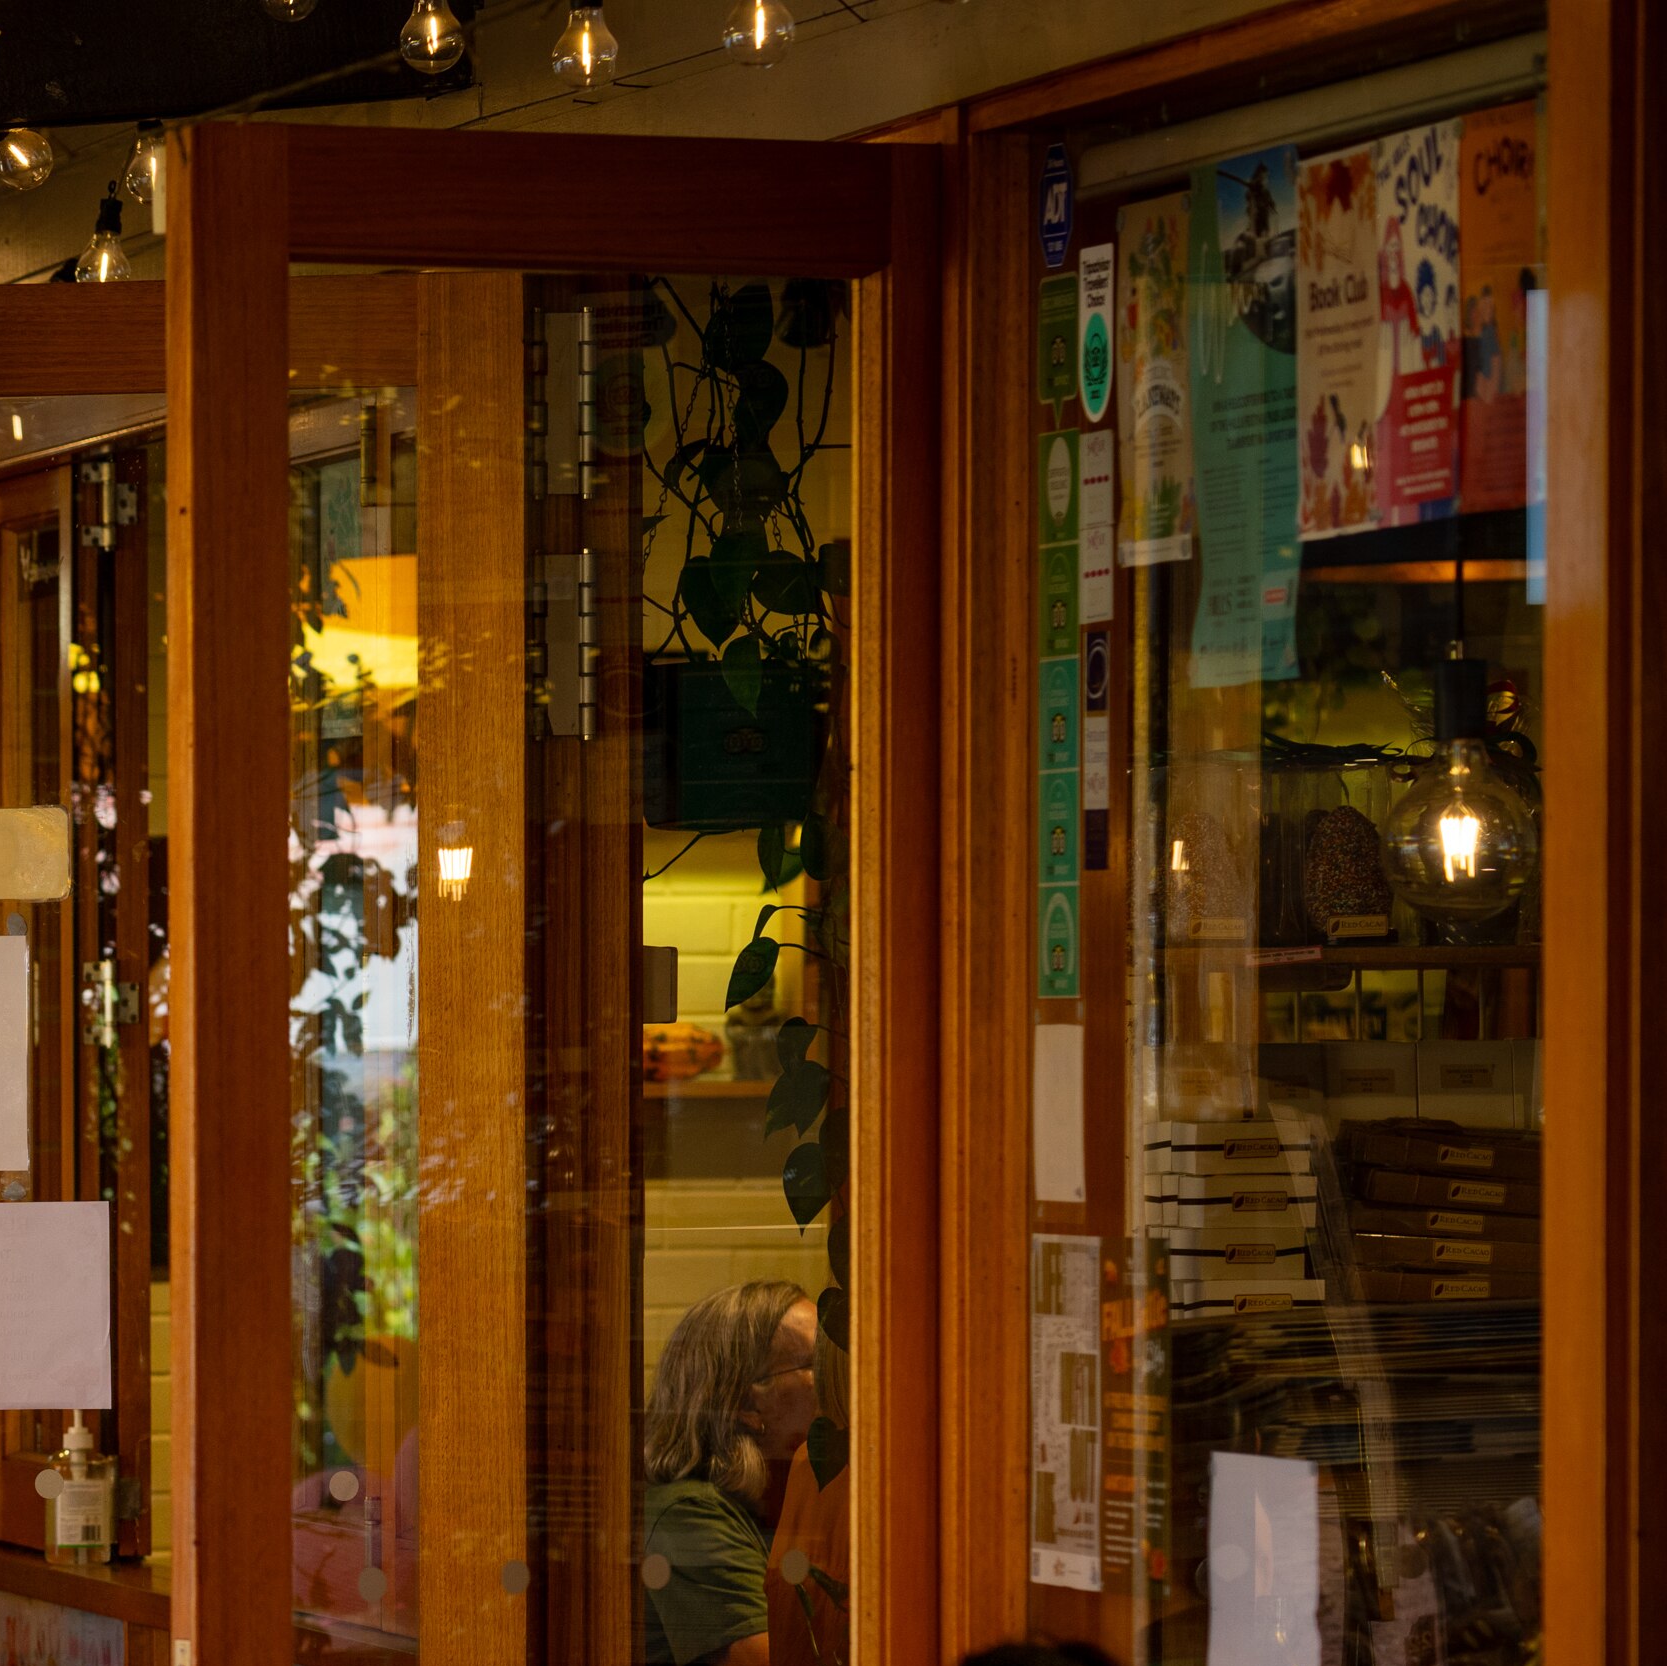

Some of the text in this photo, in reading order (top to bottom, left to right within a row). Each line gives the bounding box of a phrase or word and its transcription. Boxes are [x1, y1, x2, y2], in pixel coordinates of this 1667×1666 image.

[1395, 127, 1442, 224] SOUL
[1042, 182, 1068, 225] ADT
[1308, 271, 1368, 311] Book Club
[1450, 1150, 1492, 1161] RED CACAO
[1445, 1245, 1490, 1256] RED CACAO
[1444, 1284, 1488, 1293] RED CACAO
